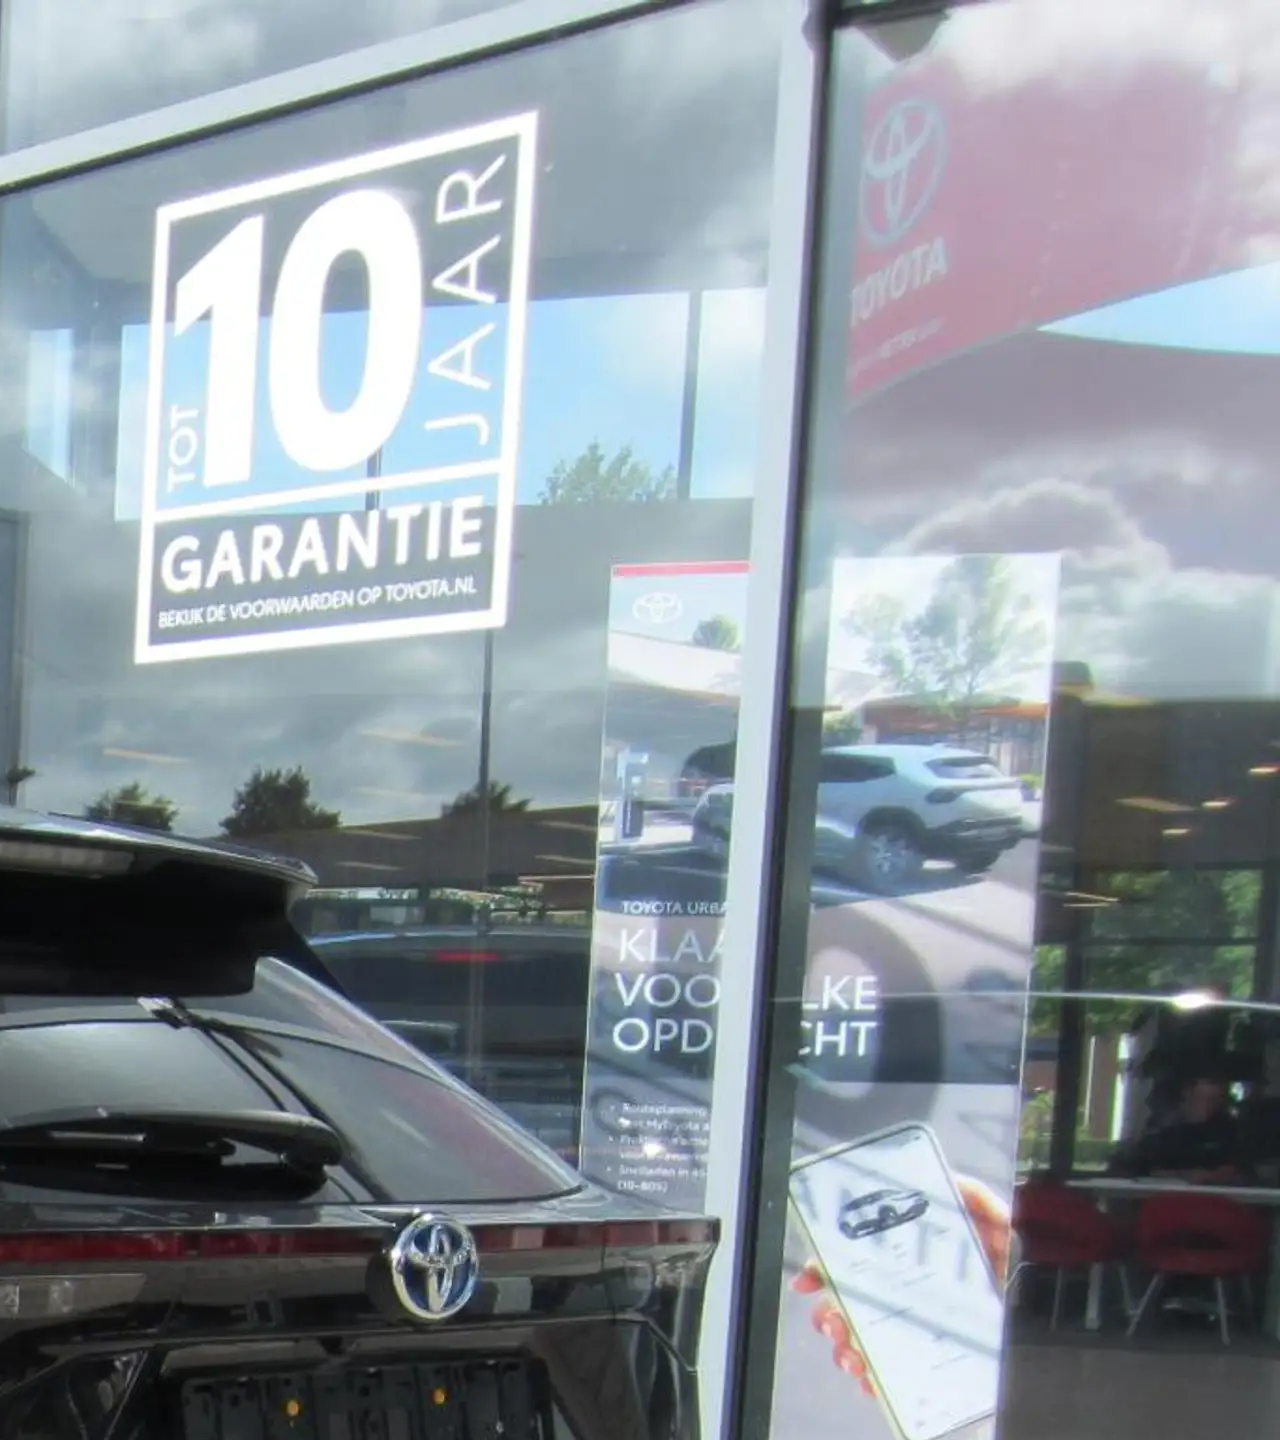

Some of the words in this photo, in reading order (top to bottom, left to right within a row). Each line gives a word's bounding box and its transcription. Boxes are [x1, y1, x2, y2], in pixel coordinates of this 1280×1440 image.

[424, 154, 506, 445] JAAR
[848, 236, 947, 330] TOYOTA
[174, 188, 423, 488] 10
[167, 403, 199, 492] TOT
[161, 495, 484, 594] GARANTIE
[158, 607, 205, 630] BEKIJK
[206, 603, 228, 623] DE
[230, 588, 354, 621] VOORWAARDEN
[357, 586, 382, 607] OP
[385, 574, 477, 602] TOYOTA.NL
[621, 901, 683, 915] TOYOTA
[614, 972, 721, 1008] VOO
